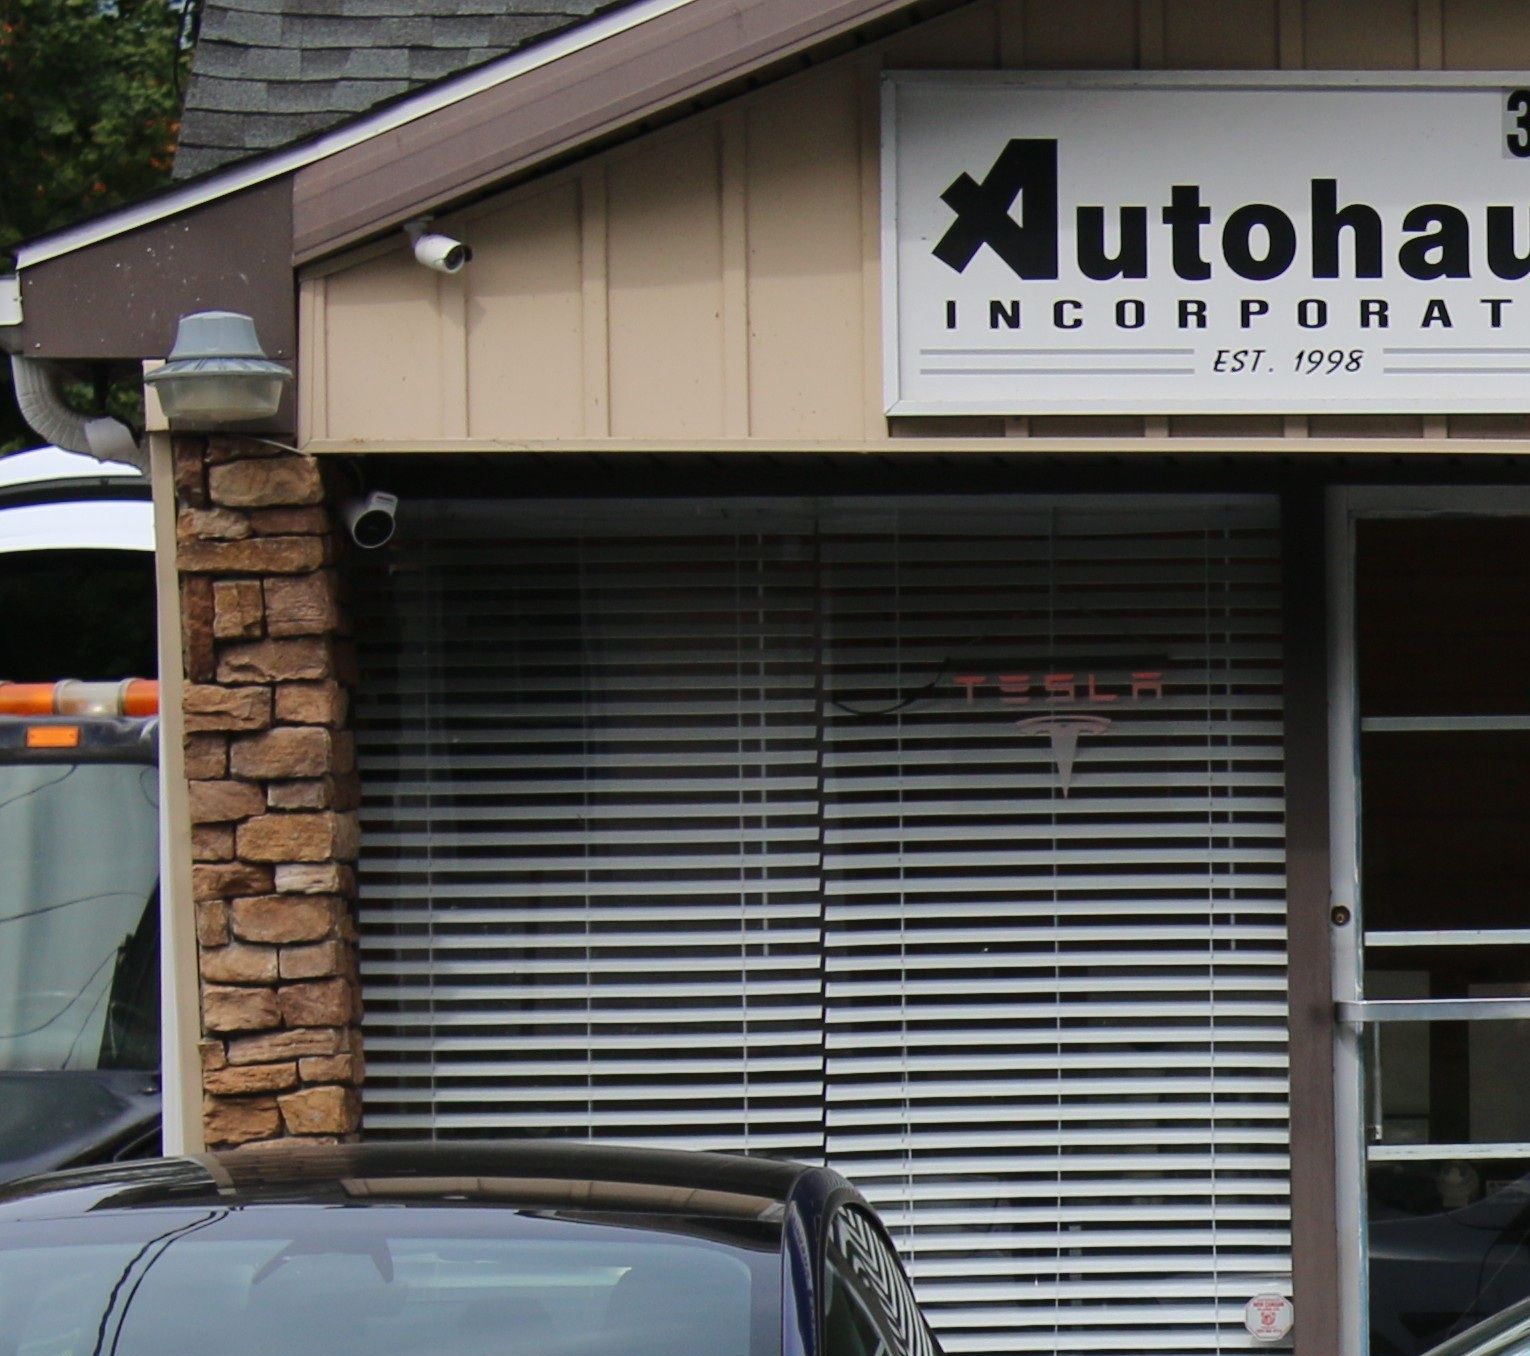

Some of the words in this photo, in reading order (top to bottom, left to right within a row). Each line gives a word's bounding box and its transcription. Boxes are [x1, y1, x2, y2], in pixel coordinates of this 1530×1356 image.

[1214, 350, 1275, 374] EST.
[1294, 348, 1364, 376] 1998
[953, 672, 1163, 703] TESLA
